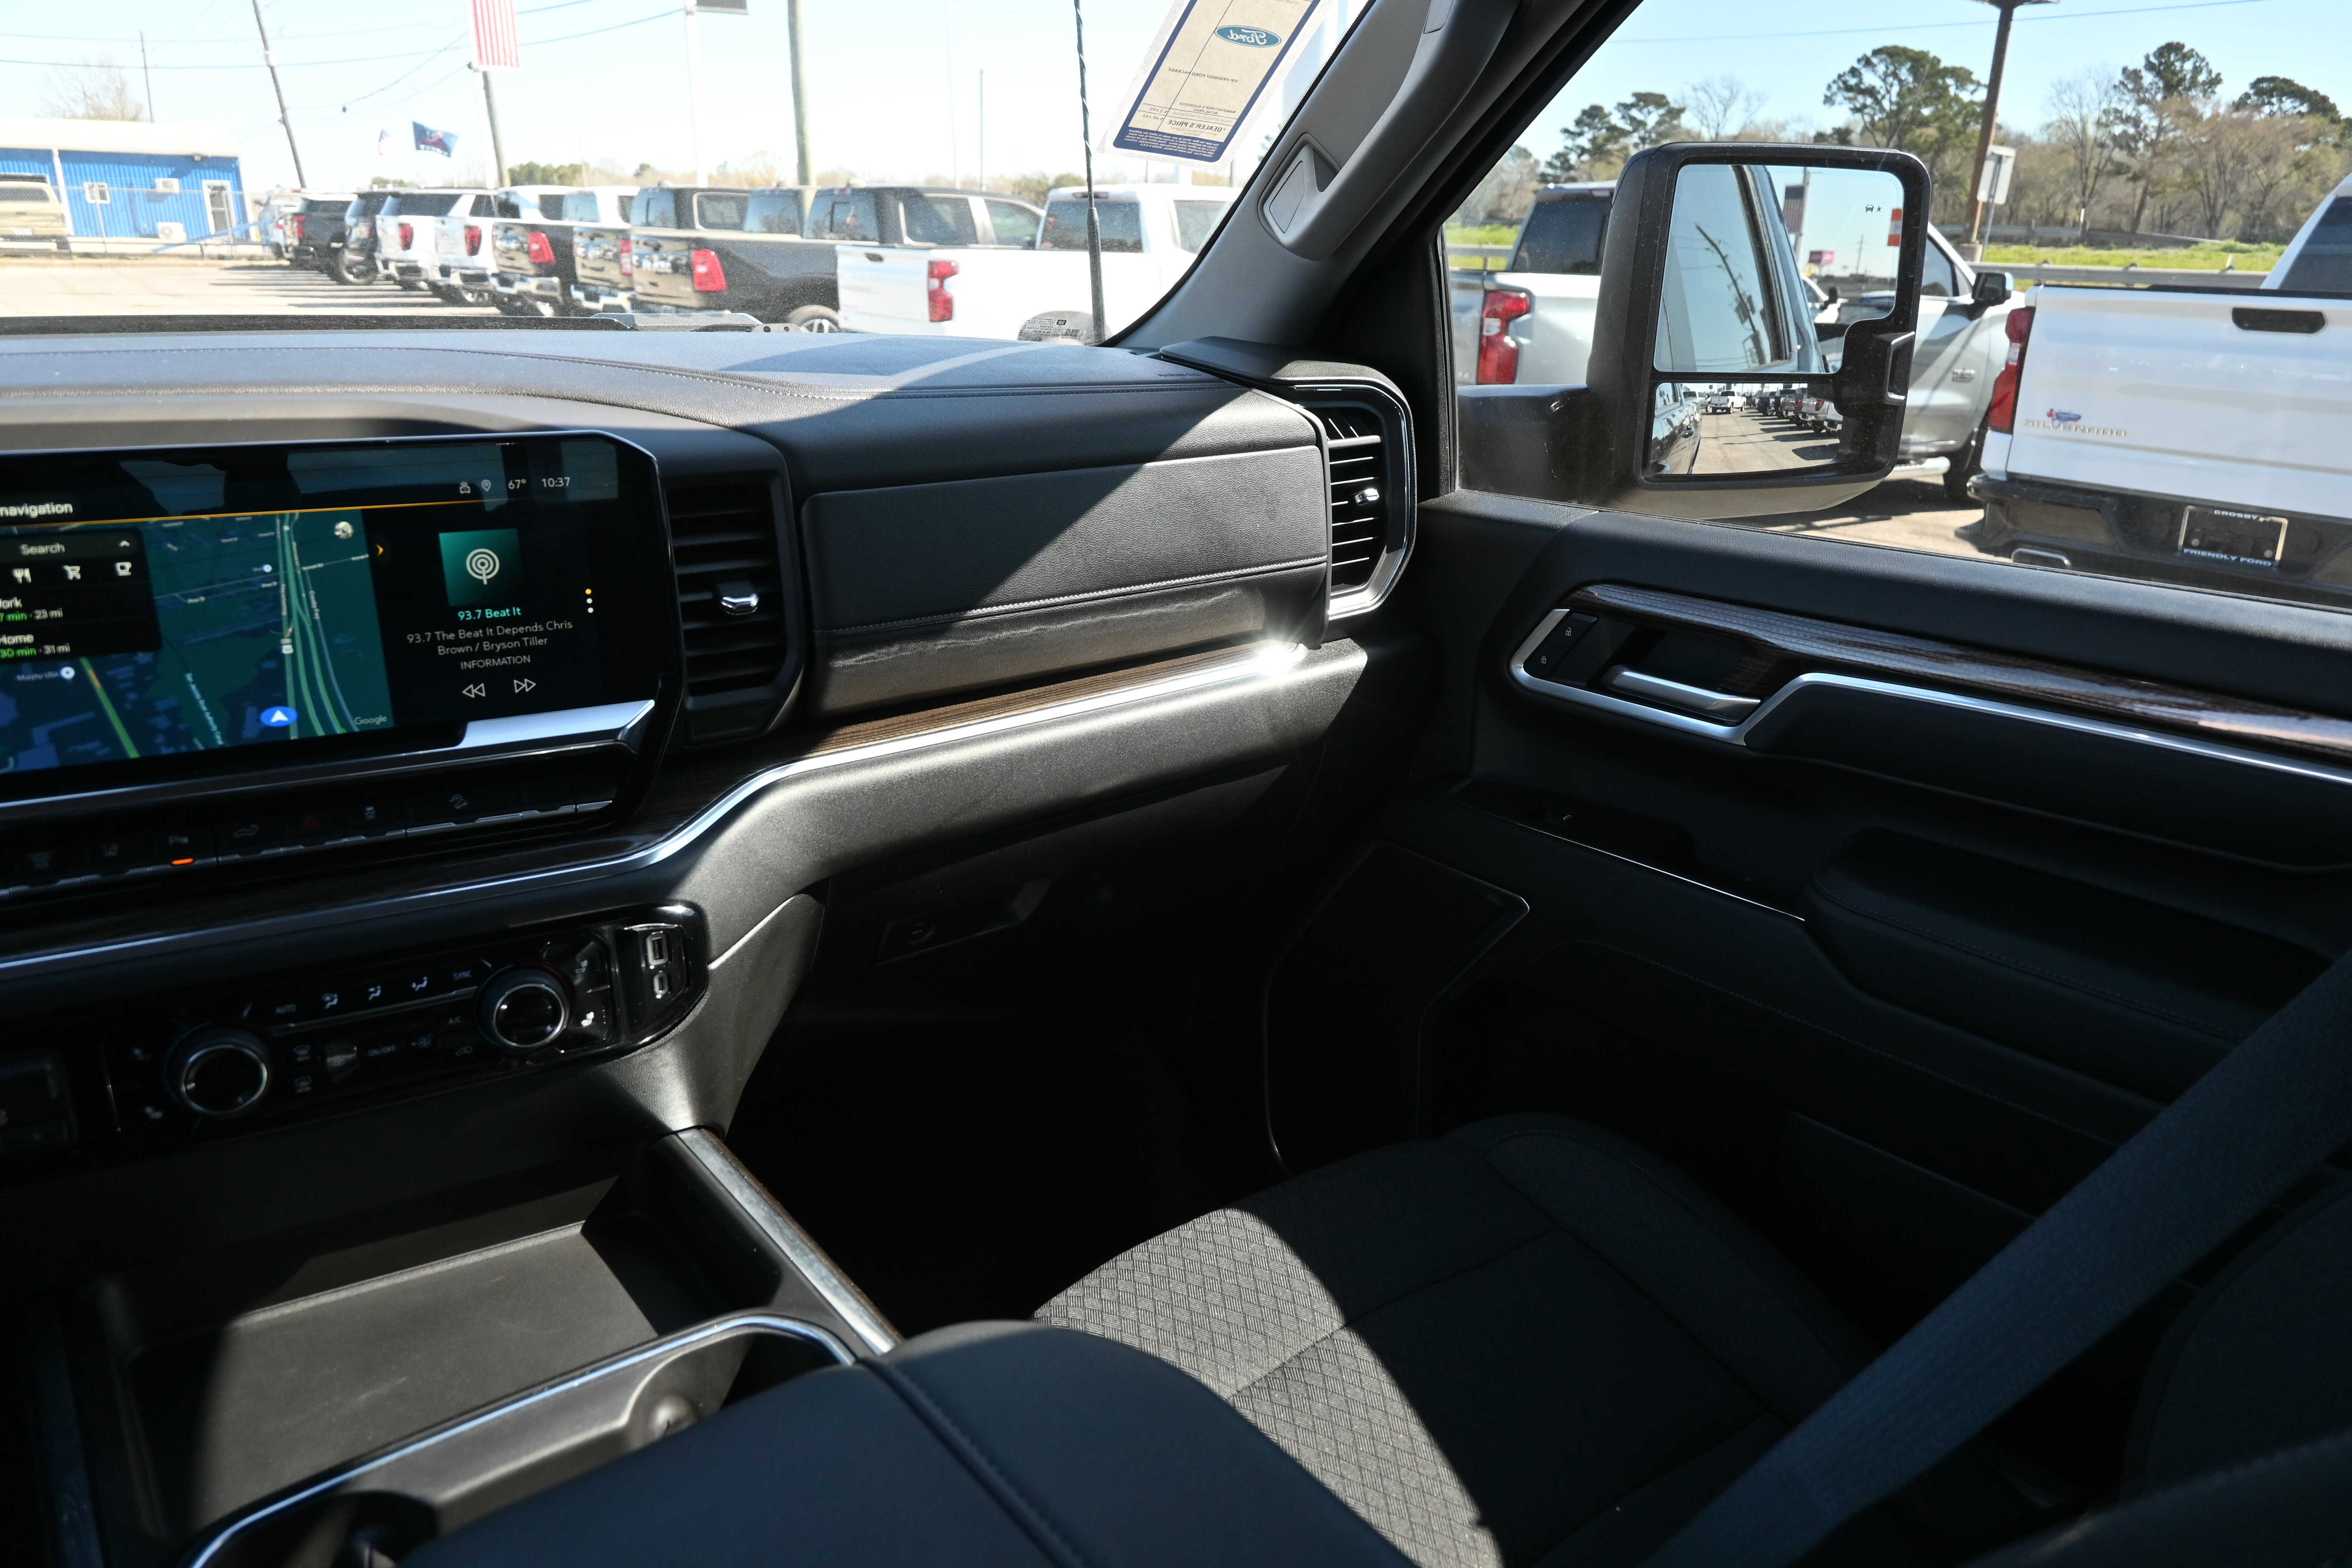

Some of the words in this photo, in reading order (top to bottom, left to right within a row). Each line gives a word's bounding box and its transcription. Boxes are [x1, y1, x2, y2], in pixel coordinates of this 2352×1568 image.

[2023, 419, 2127, 437] SILVERADO
[542, 477, 571, 488] 10:37
[0, 502, 73, 518] navigation
[2214, 509, 2259, 520] CROSBY
[20, 542, 65, 555] Search
[2183, 548, 2238, 561] FRIENDLY
[2240, 557, 2273, 567] FORD
[5, 611, 27, 622] min
[49, 607, 63, 619] mi
[458, 610, 482, 621] 93.7
[485, 608, 510, 618] Beat
[512, 607, 521, 616] It
[407, 632, 432, 643] 93.7
[435, 630, 455, 641] The
[458, 628, 484, 639] Beat
[486, 627, 494, 637] It
[496, 622, 544, 638] Depends
[546, 620, 573, 631] Chris
[15, 646, 37, 657] min
[56, 642, 71, 653] mi
[438, 643, 473, 656] Brown
[483, 640, 520, 654] Bryson
[522, 637, 548, 648] Tiller
[461, 655, 531, 670] INFORMATION
[354, 714, 387, 725] Google
[453, 970, 472, 980] SYNC
[275, 1003, 297, 1015] AUTO
